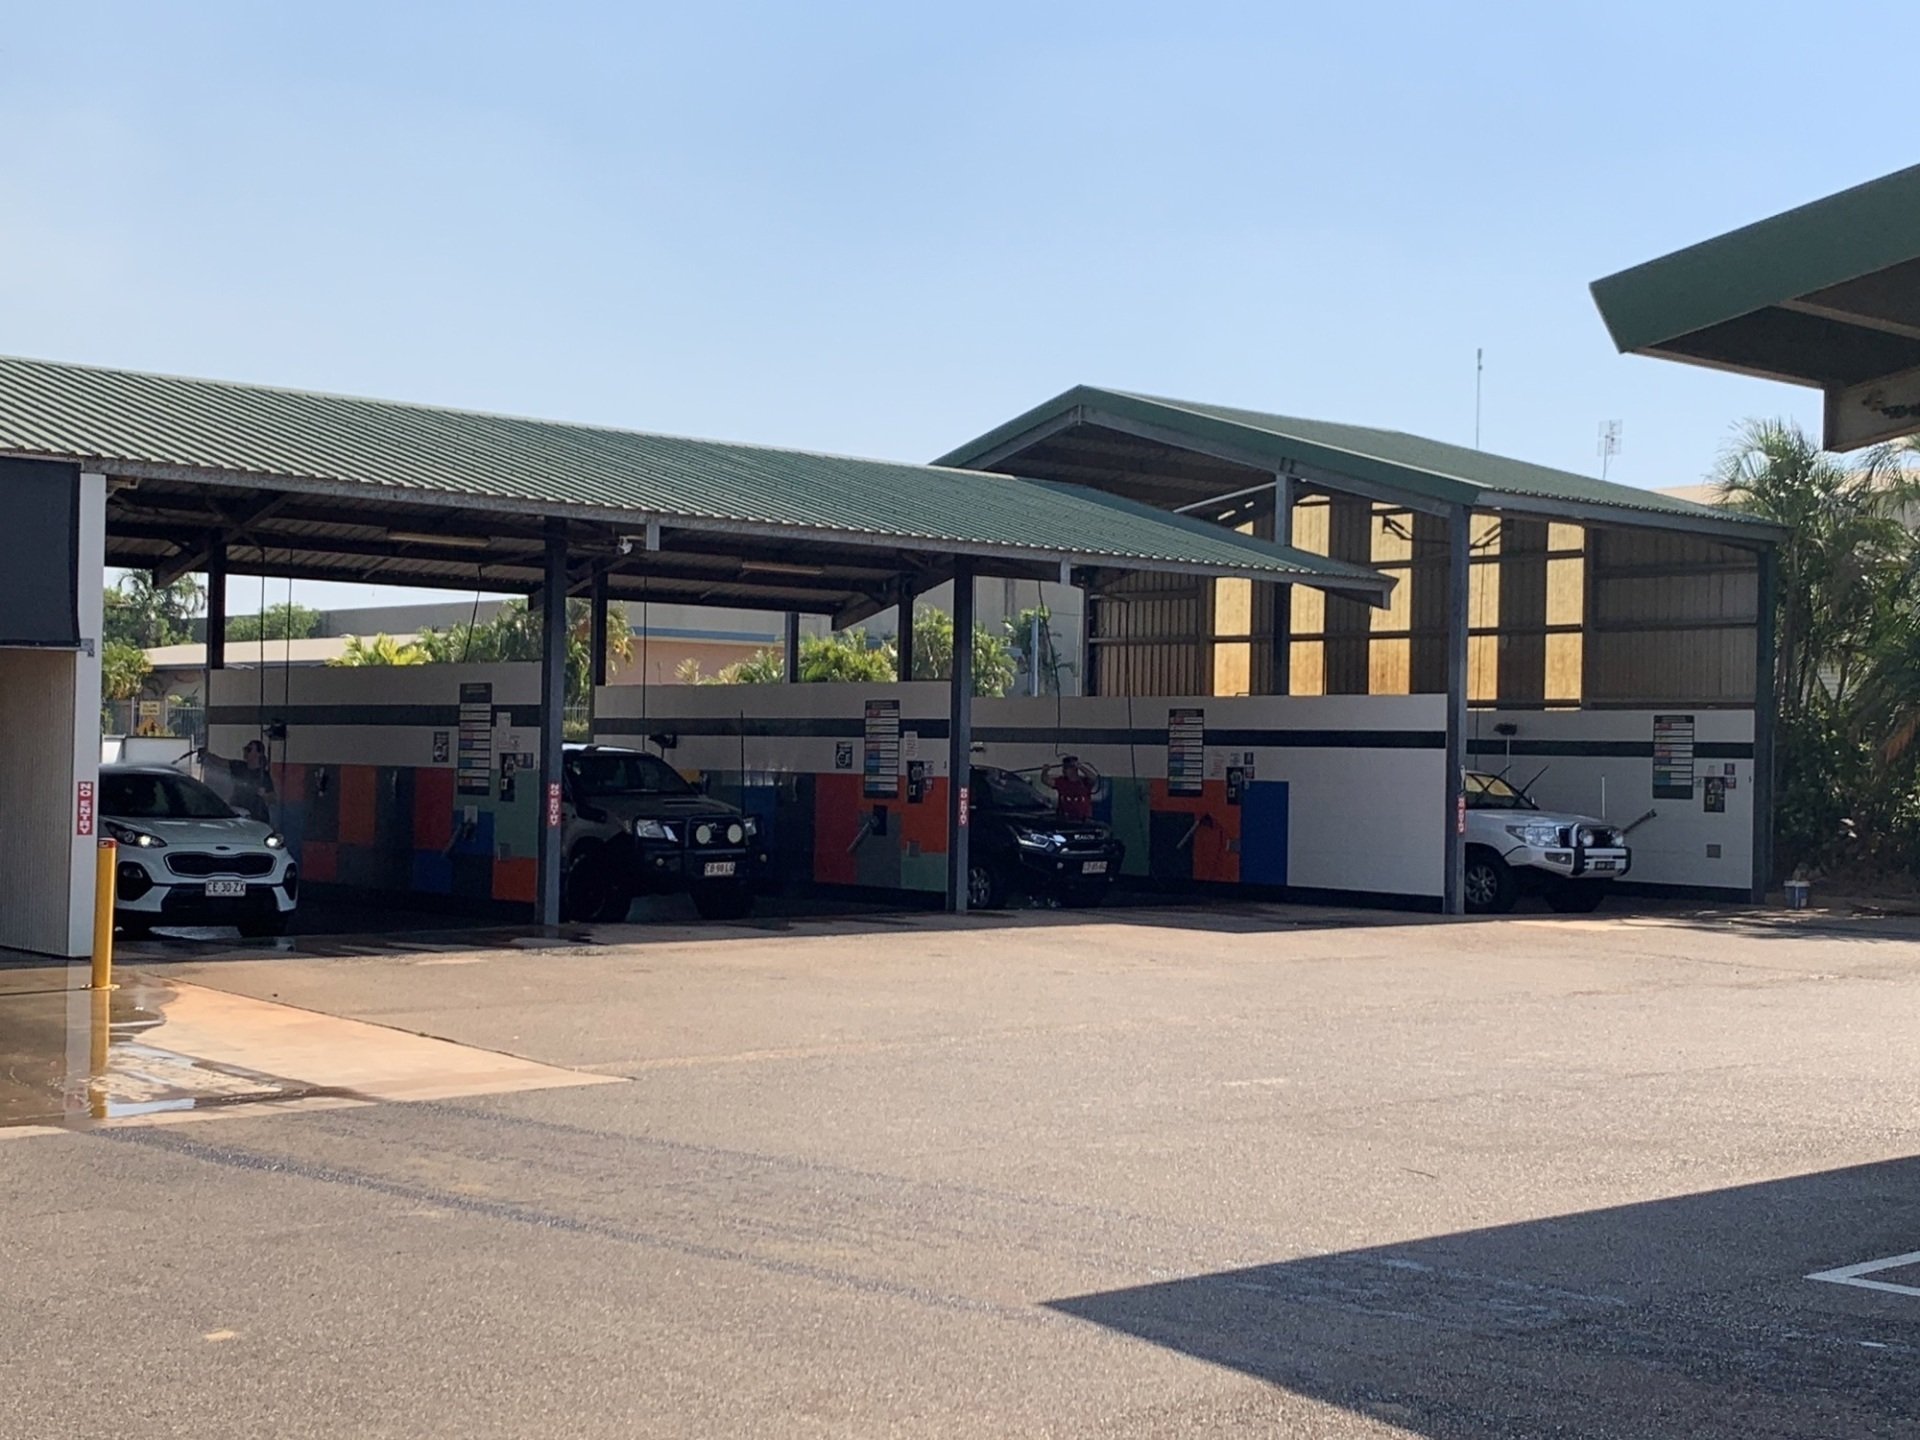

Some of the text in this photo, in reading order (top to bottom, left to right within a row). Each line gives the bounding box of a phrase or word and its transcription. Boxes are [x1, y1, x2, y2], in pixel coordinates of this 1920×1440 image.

[80, 782, 91, 834] NO ENTRY
[550, 783, 560, 826] NO ENTRY
[960, 787, 968, 798] NO
